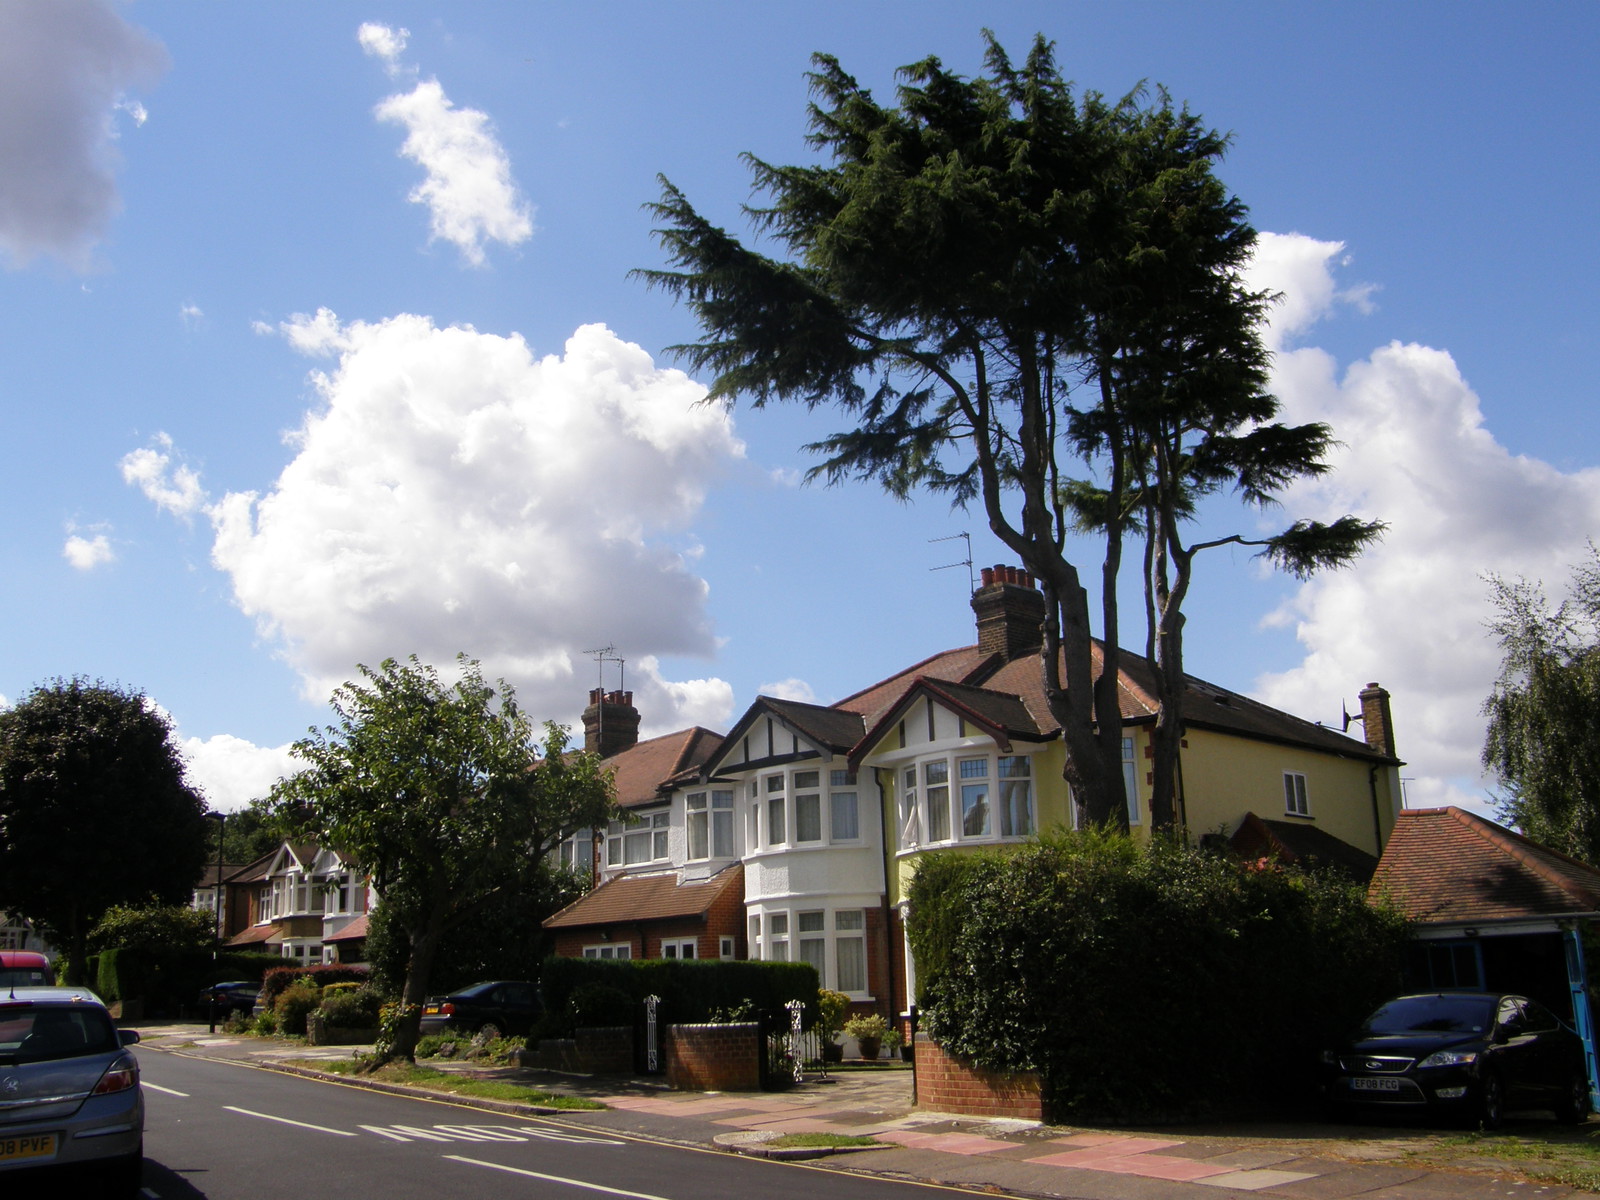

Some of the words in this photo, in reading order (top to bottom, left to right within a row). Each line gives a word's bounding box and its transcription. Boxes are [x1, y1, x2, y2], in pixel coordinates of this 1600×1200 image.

[1354, 1079, 1377, 1089] EF08
[356, 1124, 626, 1145] SLOW
[20, 1136, 50, 1153] PVF
